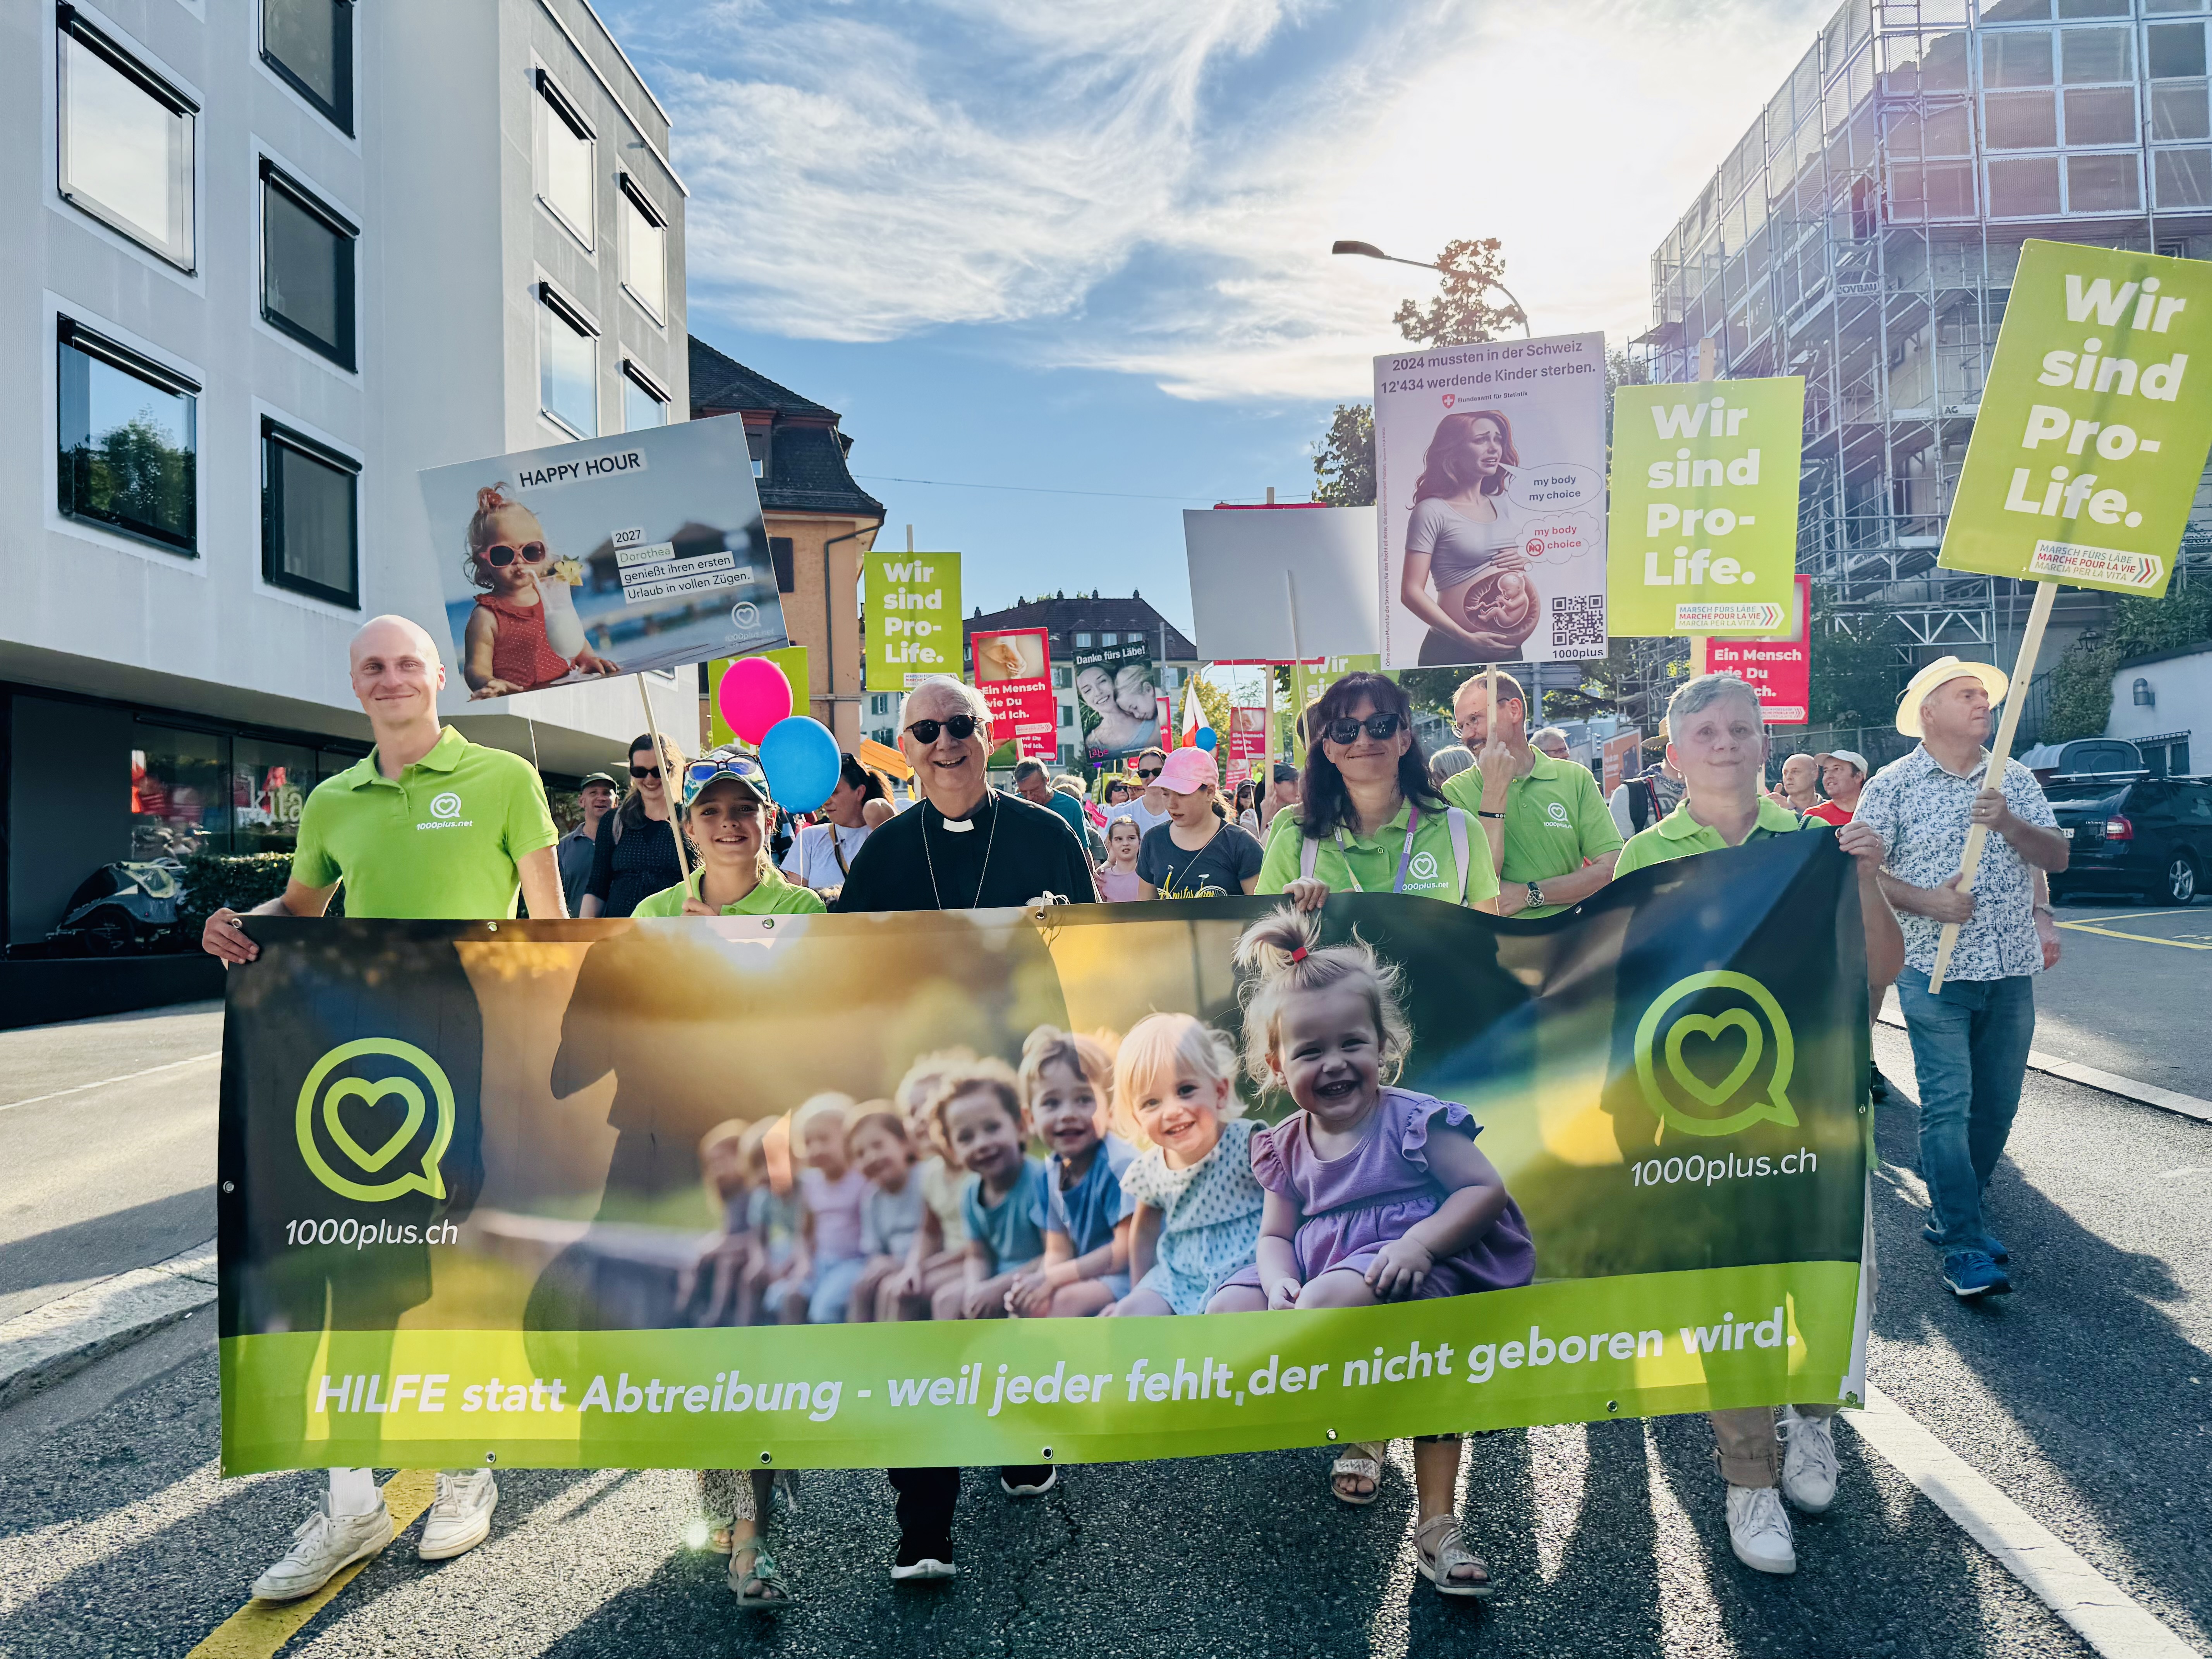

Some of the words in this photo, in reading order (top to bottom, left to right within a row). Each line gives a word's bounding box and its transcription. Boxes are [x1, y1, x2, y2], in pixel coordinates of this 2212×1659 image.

[2065, 275, 2186, 333] Wir
[1393, 357, 1425, 371] 2024
[1428, 351, 1484, 368] mussten
[1487, 349, 1499, 361] in
[1502, 347, 1523, 359] der
[1527, 340, 1583, 357] Schweiz
[1381, 378, 1424, 394] 12'434
[1427, 372, 1491, 388] werdende
[1495, 367, 1537, 381] Kinder
[1540, 362, 1596, 377] sterben.
[2037, 337, 2188, 401] sind
[1651, 397, 1748, 439] Wir
[1944, 405, 1958, 414] AG
[2021, 404, 2160, 460] Pro-
[520, 462, 579, 487] HAPPY
[586, 453, 641, 476] HOUR
[1647, 448, 1760, 489] sind
[1534, 478, 1549, 487] my
[1551, 475, 1576, 484] body
[1547, 490, 1581, 499] choice
[2004, 466, 2142, 527] Life.
[1552, 526, 1577, 534] body
[1647, 503, 1755, 537] Pro-
[615, 530, 641, 543] 2027
[1547, 540, 1581, 549] choice
[620, 547, 671, 562] Dorothea
[2037, 553, 2077, 565] MARCHE
[2079, 559, 2105, 569] POUR
[2121, 565, 2136, 573] VIE
[2040, 544, 2080, 556] MARSCH
[2083, 550, 2106, 560] FÜRS
[2109, 553, 2133, 564] LÄBE
[624, 566, 666, 583] genießt
[668, 563, 694, 574] ihren
[698, 556, 730, 568] ersten
[883, 560, 934, 582] Wir
[1644, 546, 1755, 585] Life.
[2035, 561, 2071, 573] MARCIA
[2073, 567, 2090, 575] PER
[2092, 569, 2103, 577] LA
[2106, 572, 2126, 581] VITA
[628, 587, 663, 599] Urlaub
[666, 584, 675, 592] in
[678, 579, 710, 591] vollen
[712, 572, 750, 585] Zügen.
[884, 587, 942, 609] sind
[885, 617, 941, 636] Pro-
[885, 641, 944, 663] Life.
[1076, 654, 1102, 665] Danke
[1104, 651, 1121, 660] fürs
[1122, 645, 1146, 657] Läbe!
[1553, 649, 1604, 659] 1000plus
[1714, 648, 1739, 660] Ein
[1743, 649, 1802, 661] Mensch
[1747, 668, 1768, 678] Du
[982, 685, 1000, 694] Ein
[1002, 682, 1046, 694] Mensch
[1753, 685, 1777, 697] ch.
[1006, 698, 1022, 706] Du
[993, 711, 1006, 720] nd
[1009, 709, 1030, 719] Ich.
[416, 820, 473, 831] 1000plus.net
[1402, 882, 1449, 891] 000plus.net
[1630, 1146, 1817, 1187] 1000plus.ch
[285, 1219, 459, 1250] 1000plus.ch
[314, 1374, 450, 1412] HILFE
[461, 1378, 567, 1413] statt
[577, 1370, 843, 1421] Abtreibung
[887, 1363, 982, 1407] weil
[988, 1361, 1113, 1417] jeder
[1342, 1340, 1455, 1387] nicht
[1467, 1325, 1663, 1384] geboren
[1679, 1306, 1796, 1354] wird.
